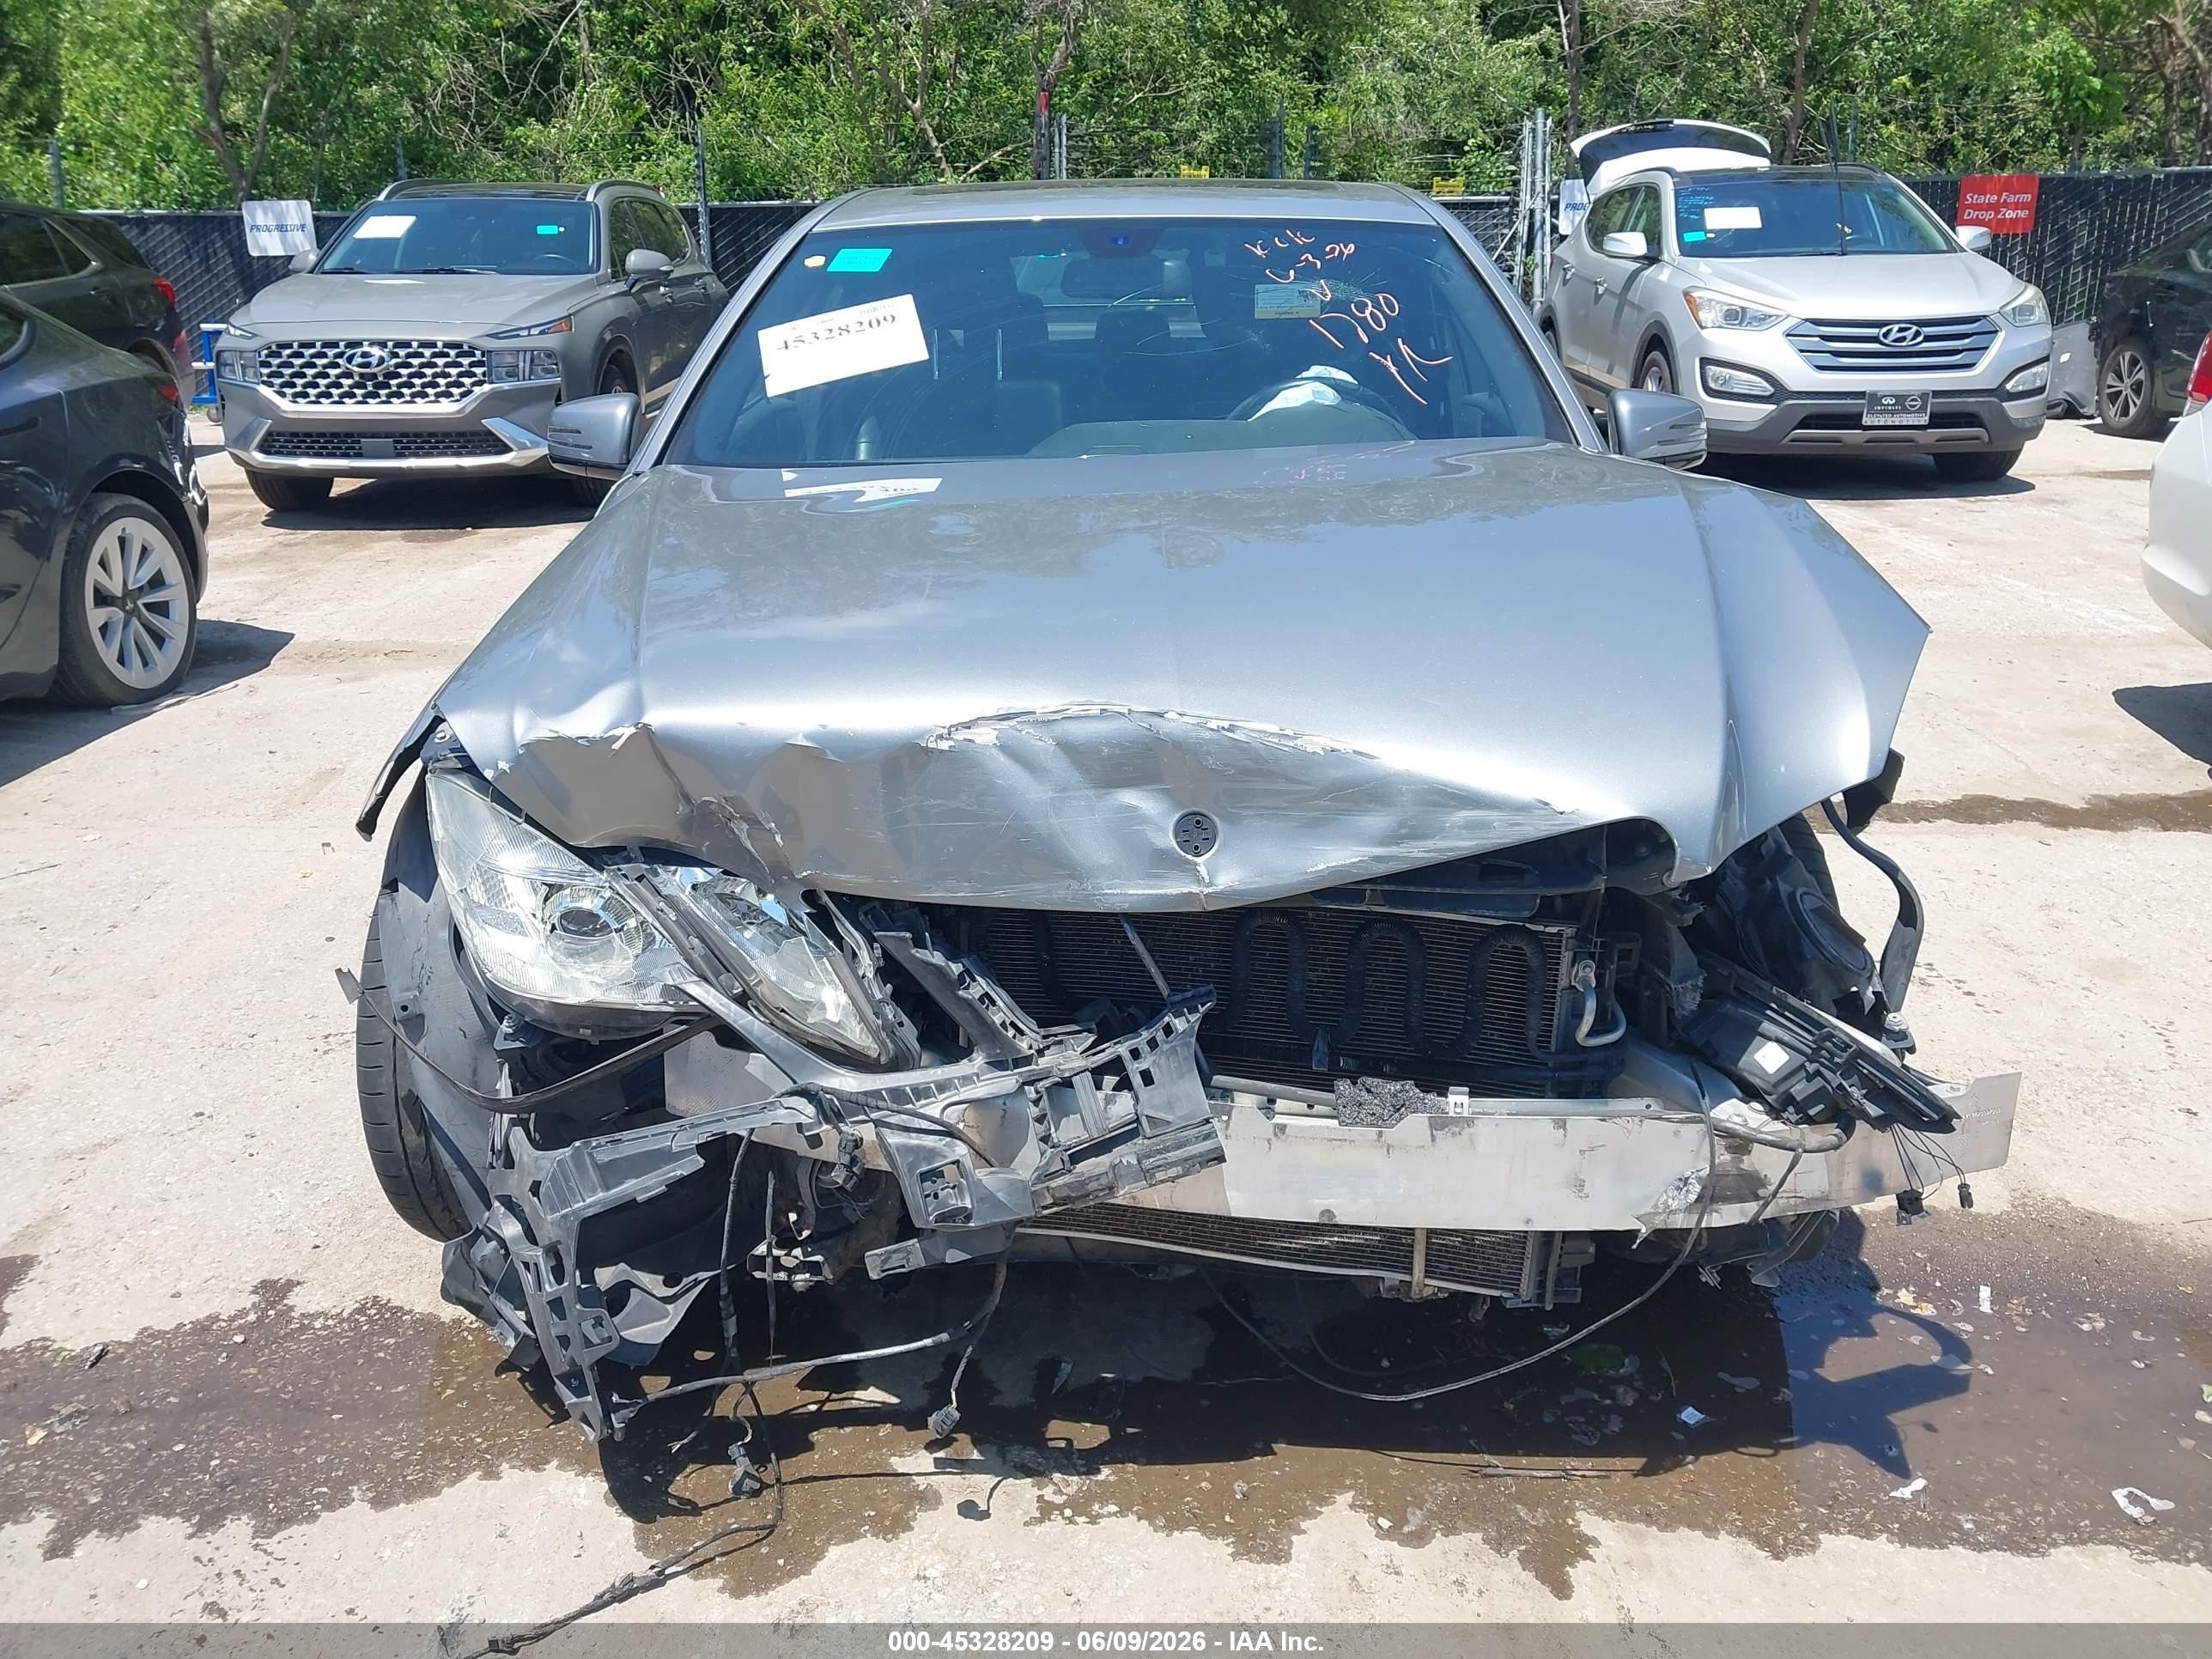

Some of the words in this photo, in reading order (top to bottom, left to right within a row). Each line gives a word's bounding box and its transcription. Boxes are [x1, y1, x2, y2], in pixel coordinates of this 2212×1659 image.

[1964, 193, 1998, 204] State
[2000, 192, 2033, 204] Farm
[1963, 209, 1995, 222] Drop
[1997, 208, 2030, 219] Zone
[249, 223, 307, 234] PROGRESSIVE
[776, 313, 896, 350] 45328209
